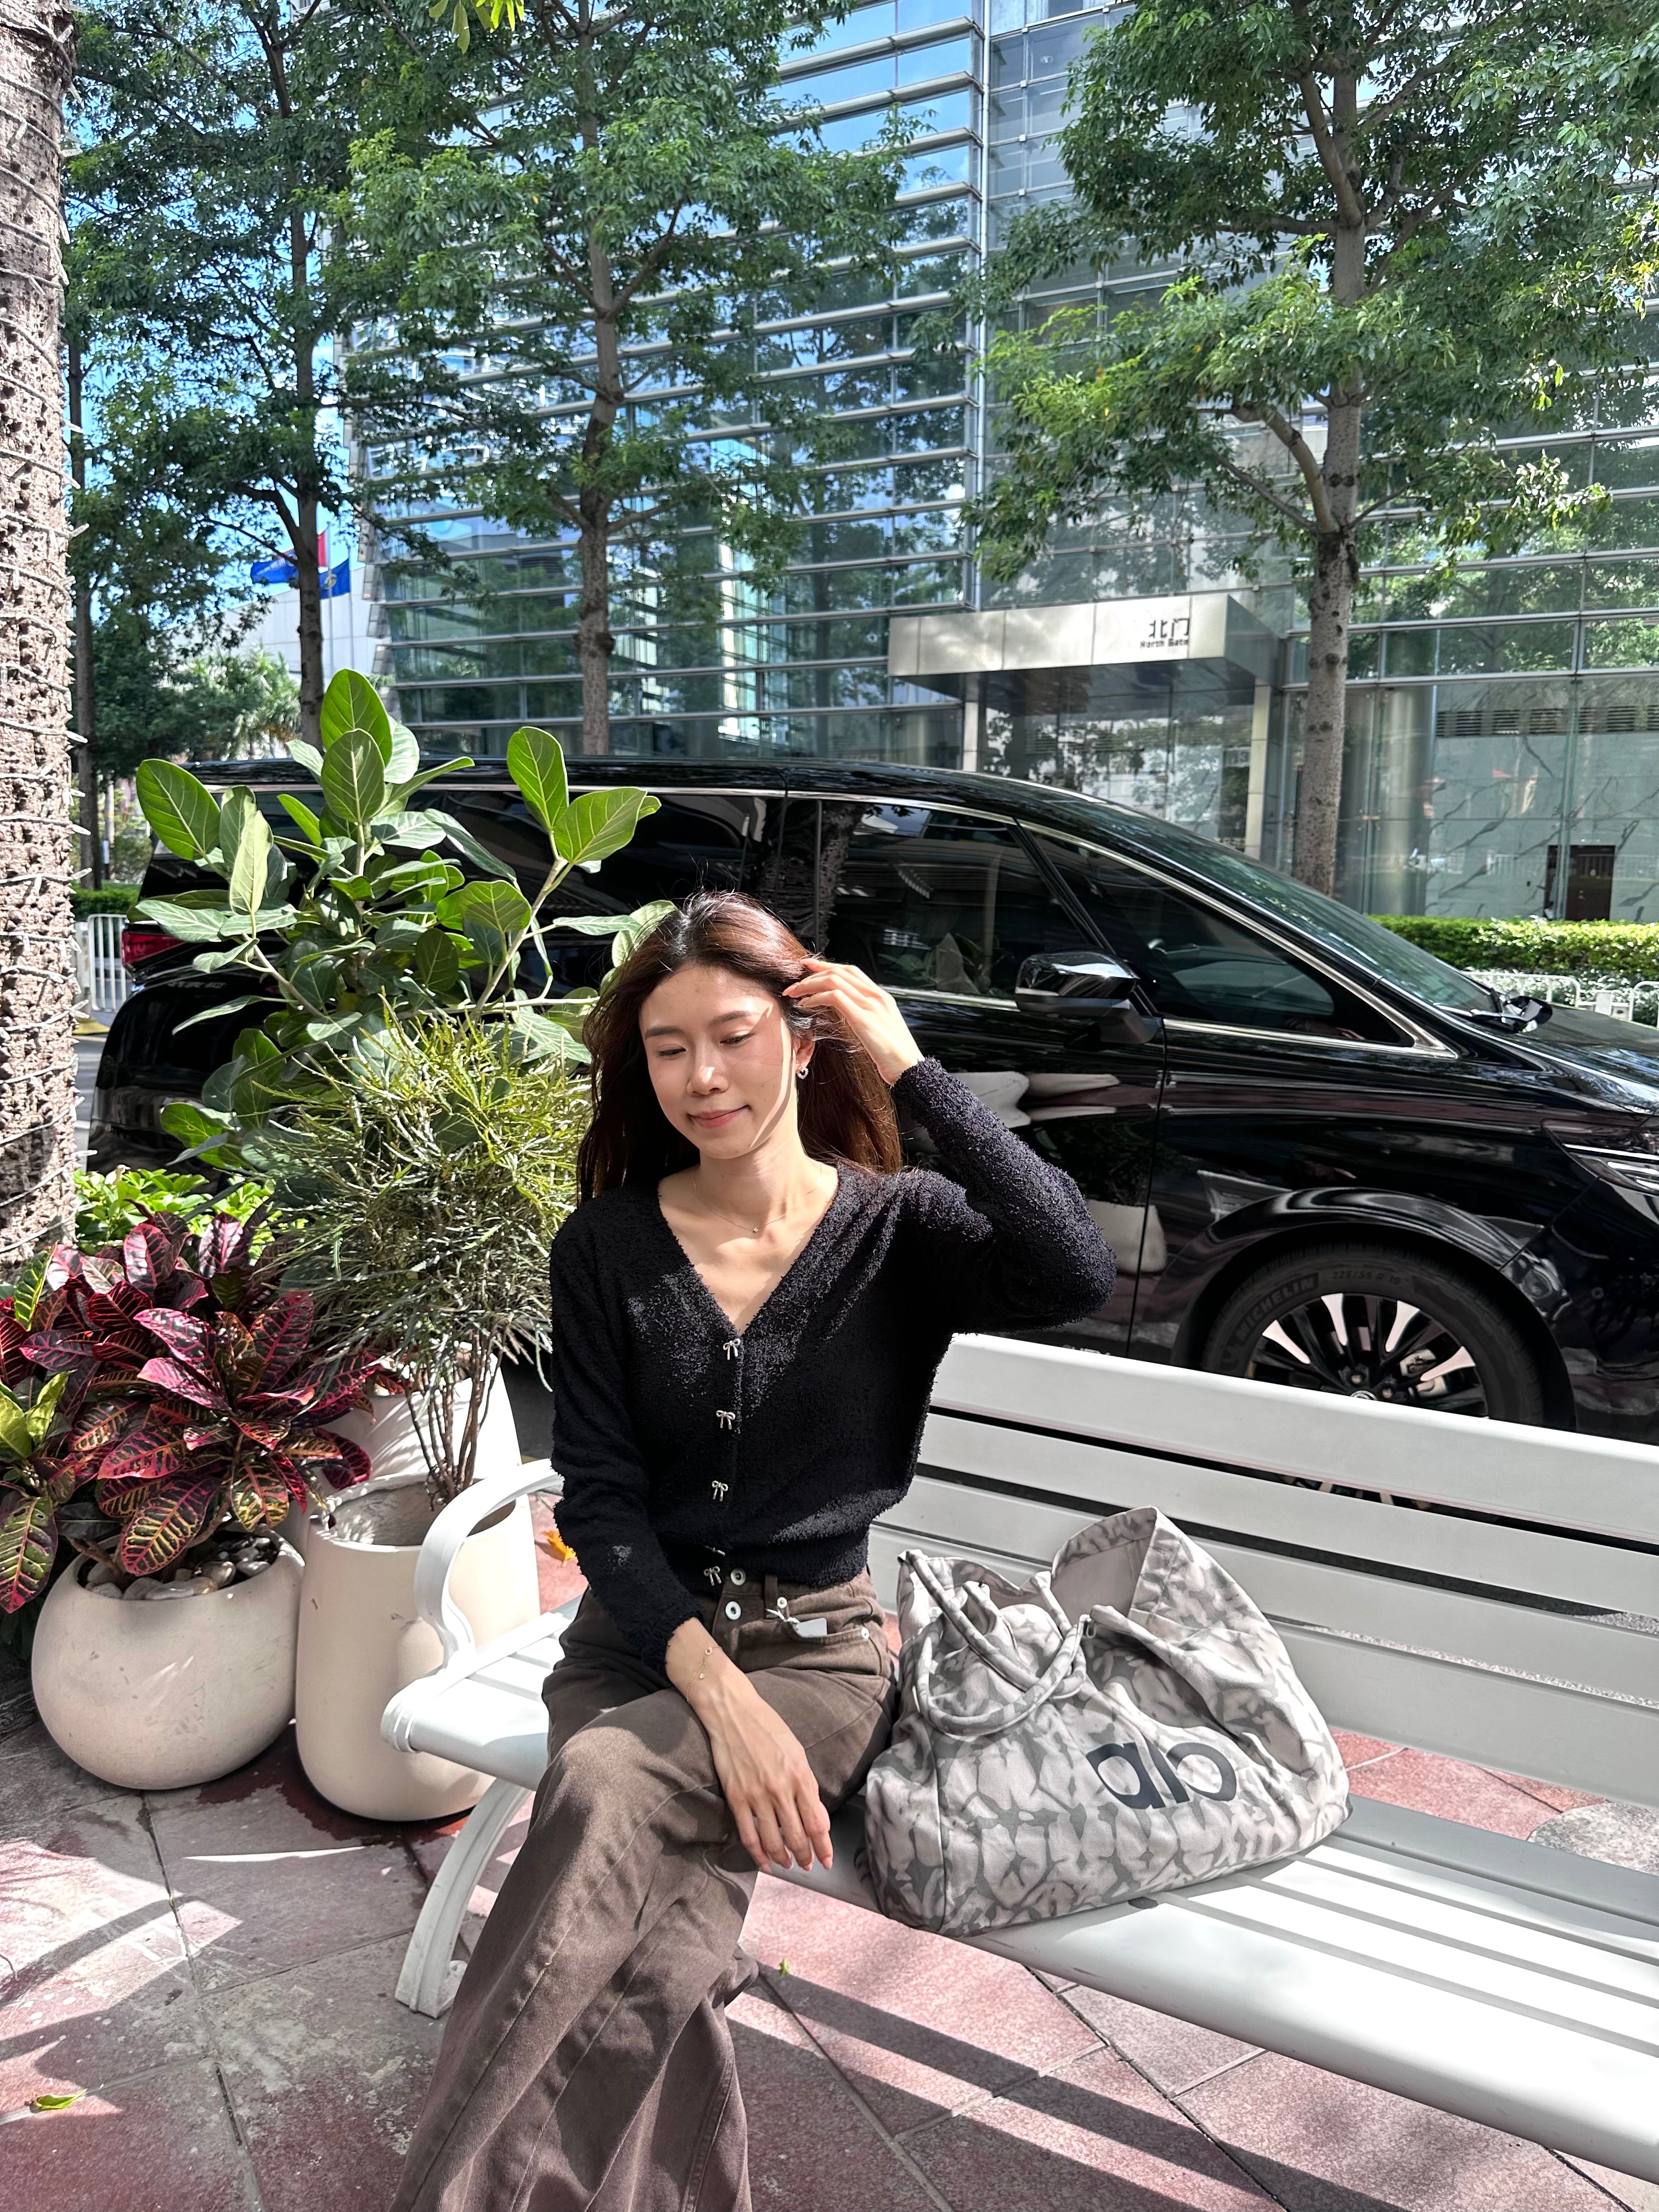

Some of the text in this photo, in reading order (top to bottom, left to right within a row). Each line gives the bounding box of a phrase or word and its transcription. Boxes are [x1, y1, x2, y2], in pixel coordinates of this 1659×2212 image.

[1148, 618, 1190, 639] 北门
[1235, 1276, 1314, 1342] MICHELIN
[1086, 1740, 1237, 1809] alo
